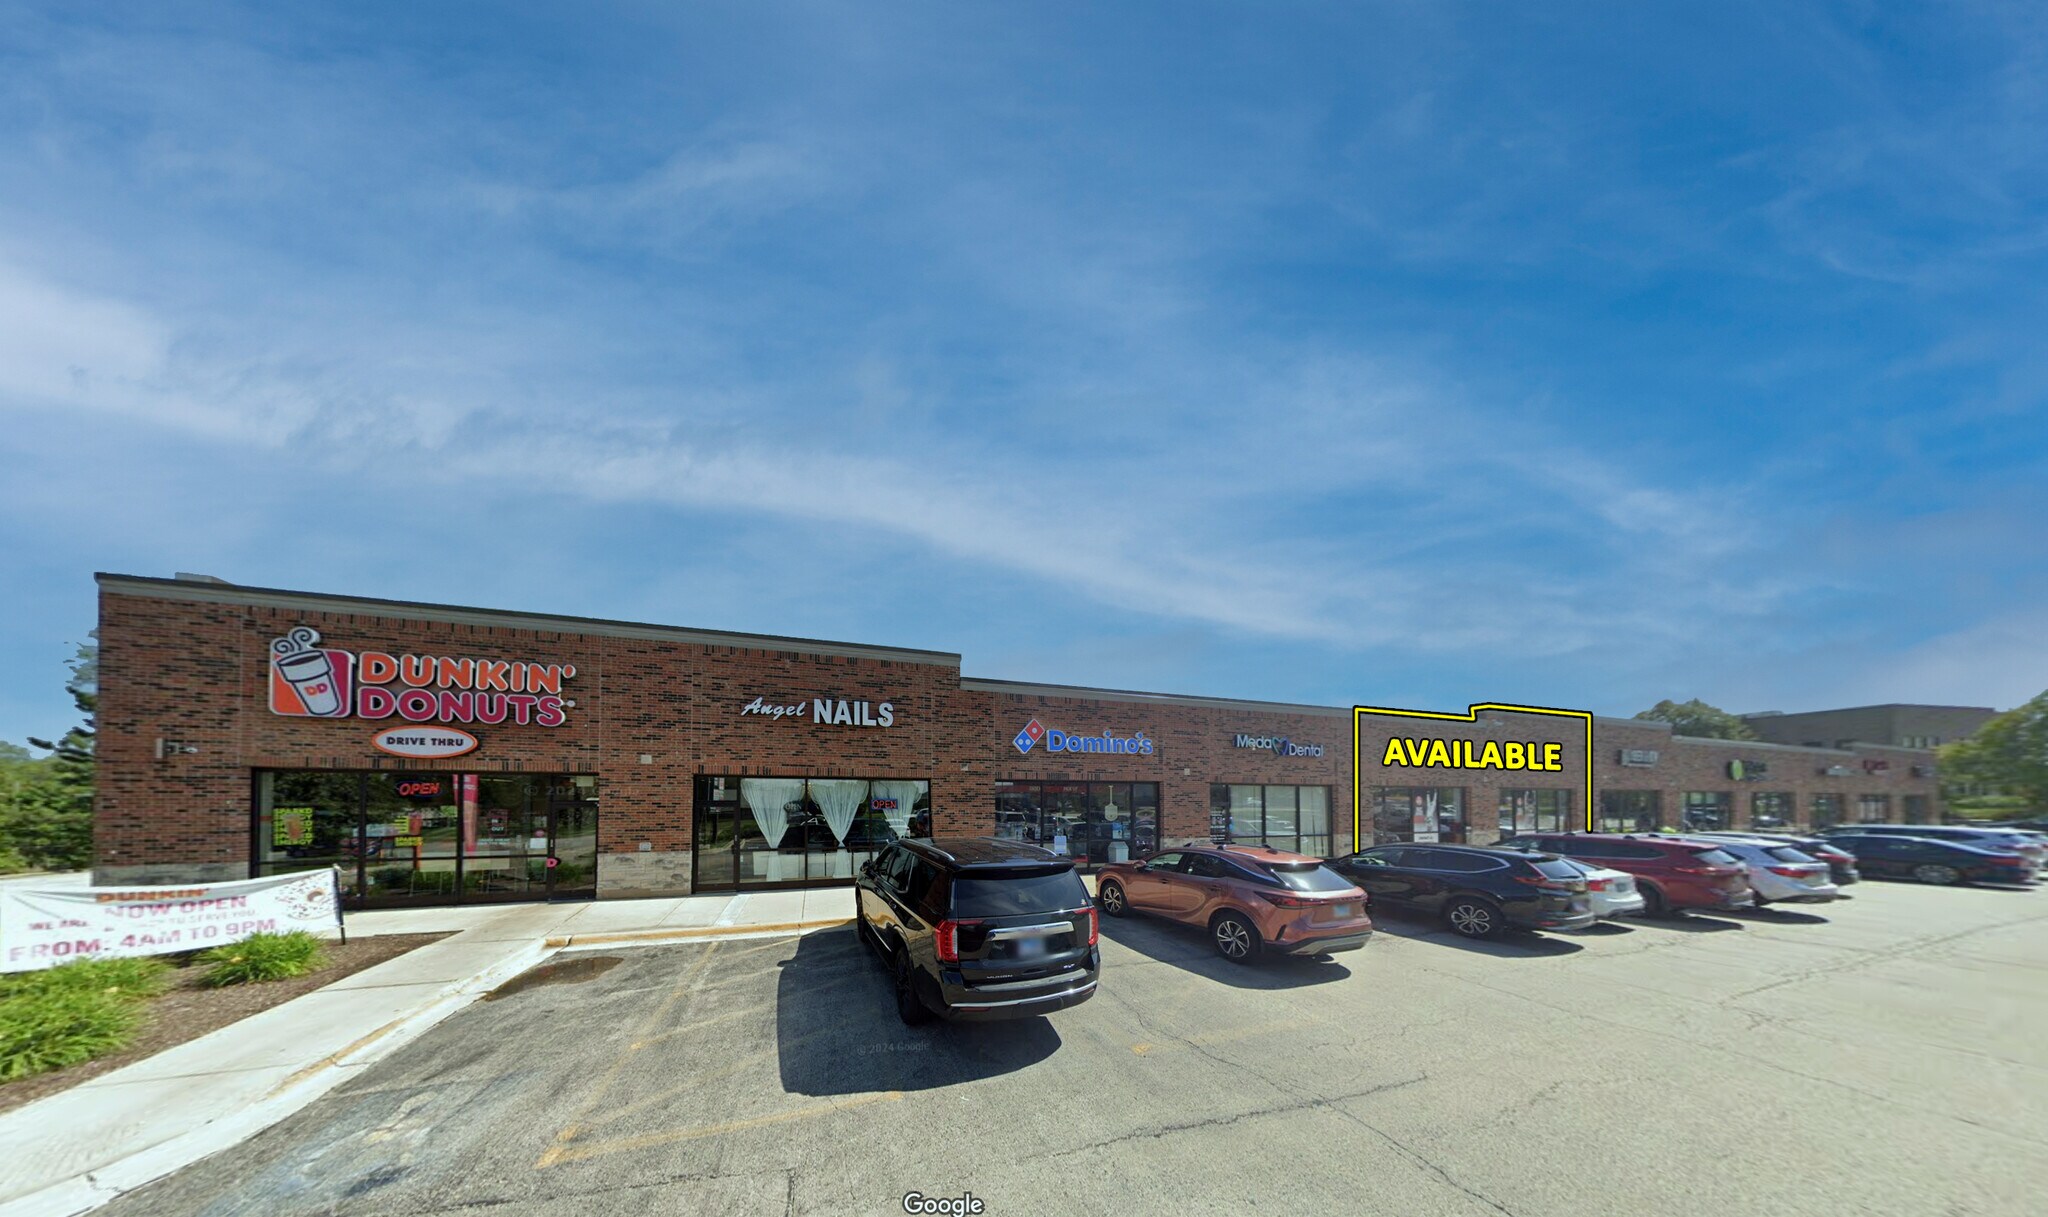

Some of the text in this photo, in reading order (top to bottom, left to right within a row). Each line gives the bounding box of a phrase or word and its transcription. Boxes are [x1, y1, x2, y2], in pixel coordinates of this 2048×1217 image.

[359, 652, 576, 694] DUNKIN'
[305, 683, 328, 696] DD
[358, 686, 566, 726] DONUTS
[741, 697, 894, 727] Angel NAILS
[386, 736, 464, 747] DRIVE THRU
[1046, 729, 1153, 755] Domino's
[1236, 734, 1324, 757] Meda Dental
[400, 782, 440, 796] OPEN
[873, 799, 897, 809] OPEN
[105, 896, 247, 919] NOW OPEN
[120, 930, 181, 947] 4AM
[190, 925, 217, 940] TO
[225, 918, 277, 935] 9PM
